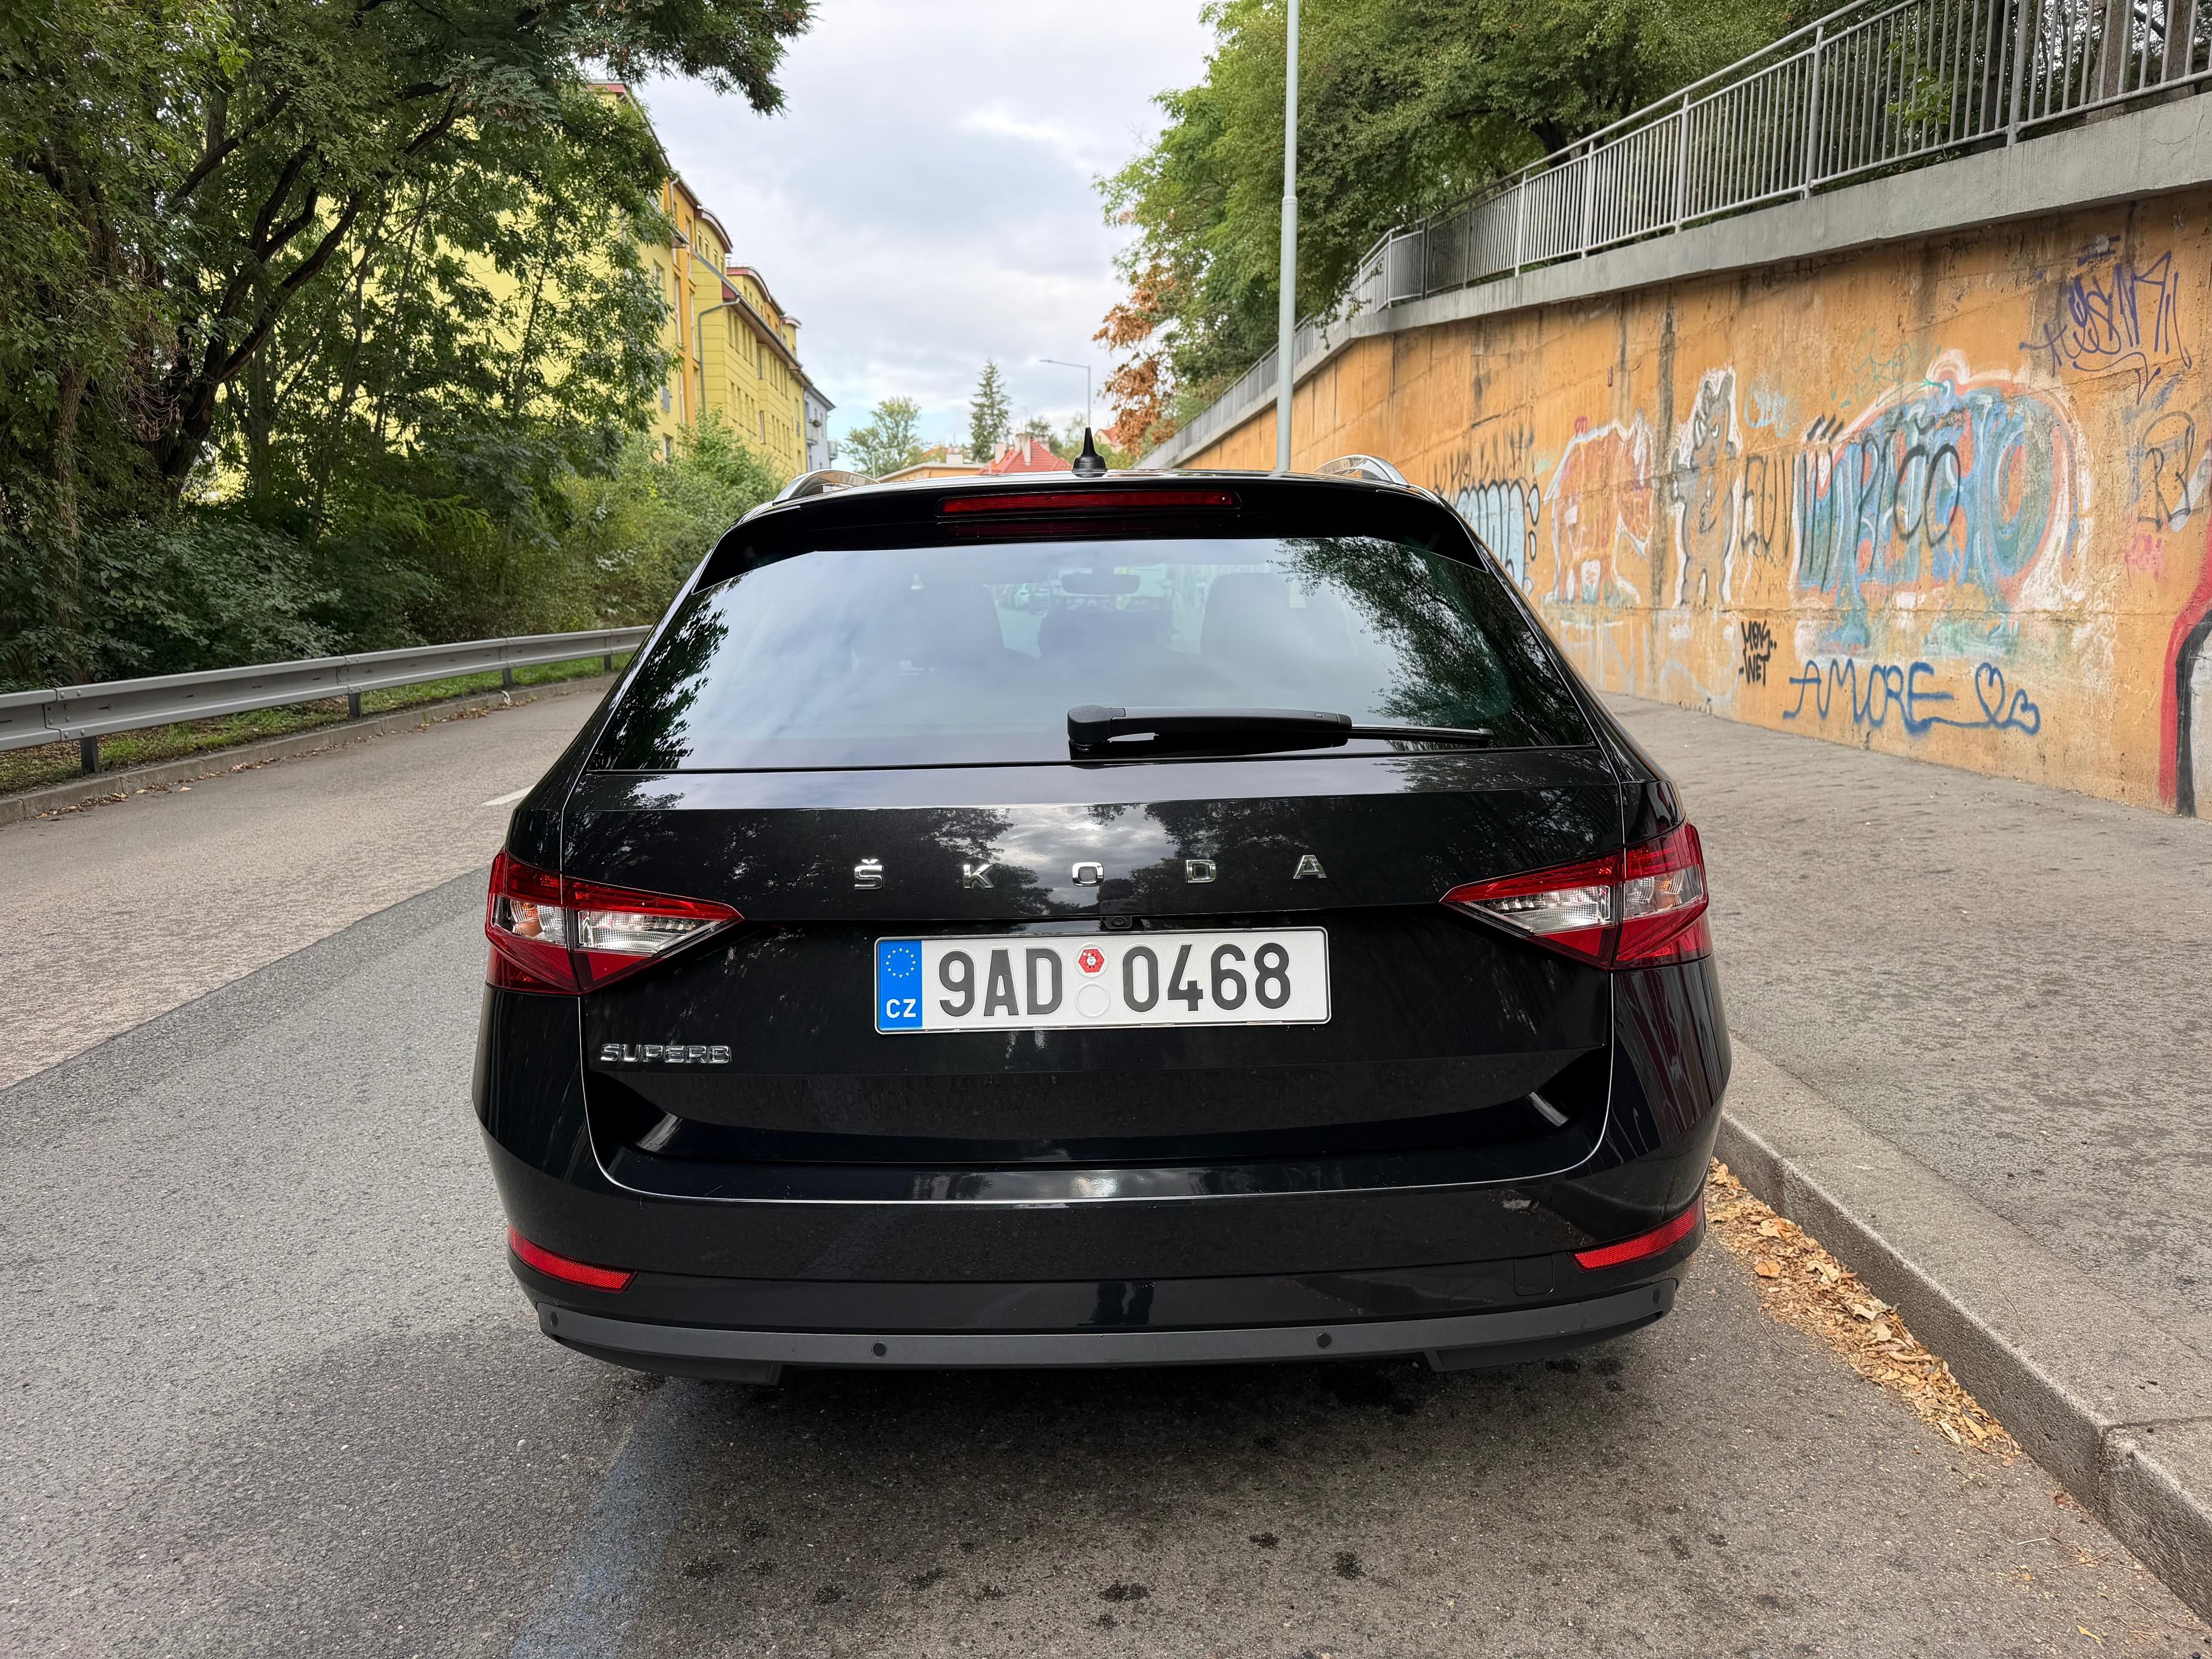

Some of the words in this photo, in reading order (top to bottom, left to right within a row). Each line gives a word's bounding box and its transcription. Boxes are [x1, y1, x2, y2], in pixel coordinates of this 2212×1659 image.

[1783, 658, 1954, 734] AMORE
[854, 854, 1328, 890] ŠKODA
[939, 948, 1063, 1017] 9AD
[1122, 942, 1291, 1013] 0468
[886, 999, 917, 1019] CZ
[601, 1043, 732, 1064] SUPERB
